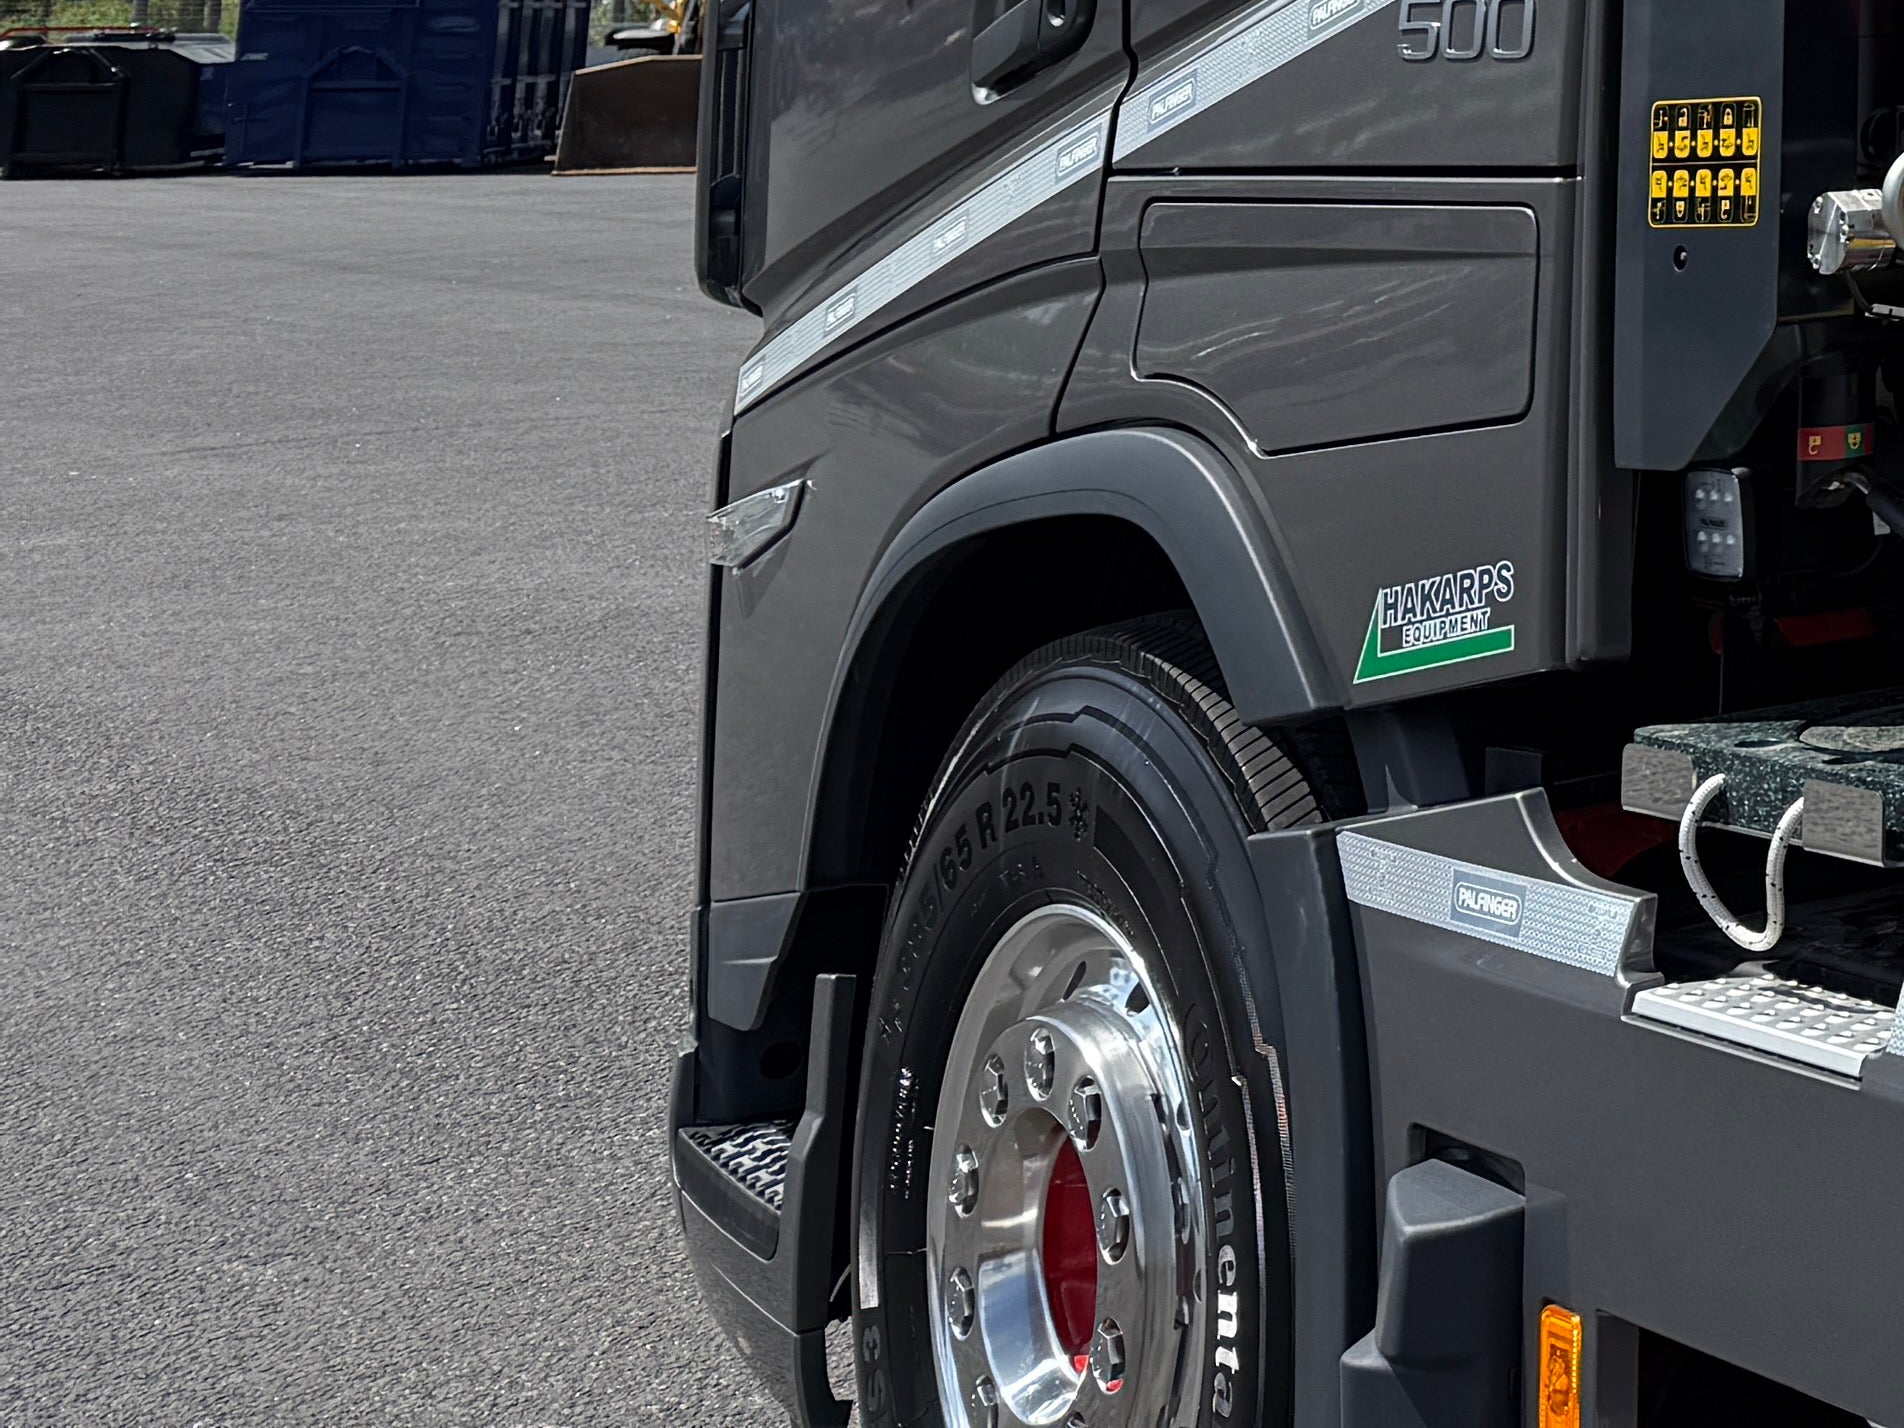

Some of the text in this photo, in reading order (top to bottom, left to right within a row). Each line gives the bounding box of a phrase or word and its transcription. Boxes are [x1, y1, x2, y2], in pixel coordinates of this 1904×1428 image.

[1380, 560, 1515, 629] HAKARPS
[1402, 607, 1491, 648] EQUIPMENT
[976, 801, 998, 849] R
[1002, 781, 1063, 834] 22.5
[1458, 886, 1518, 920] PALFINGER
